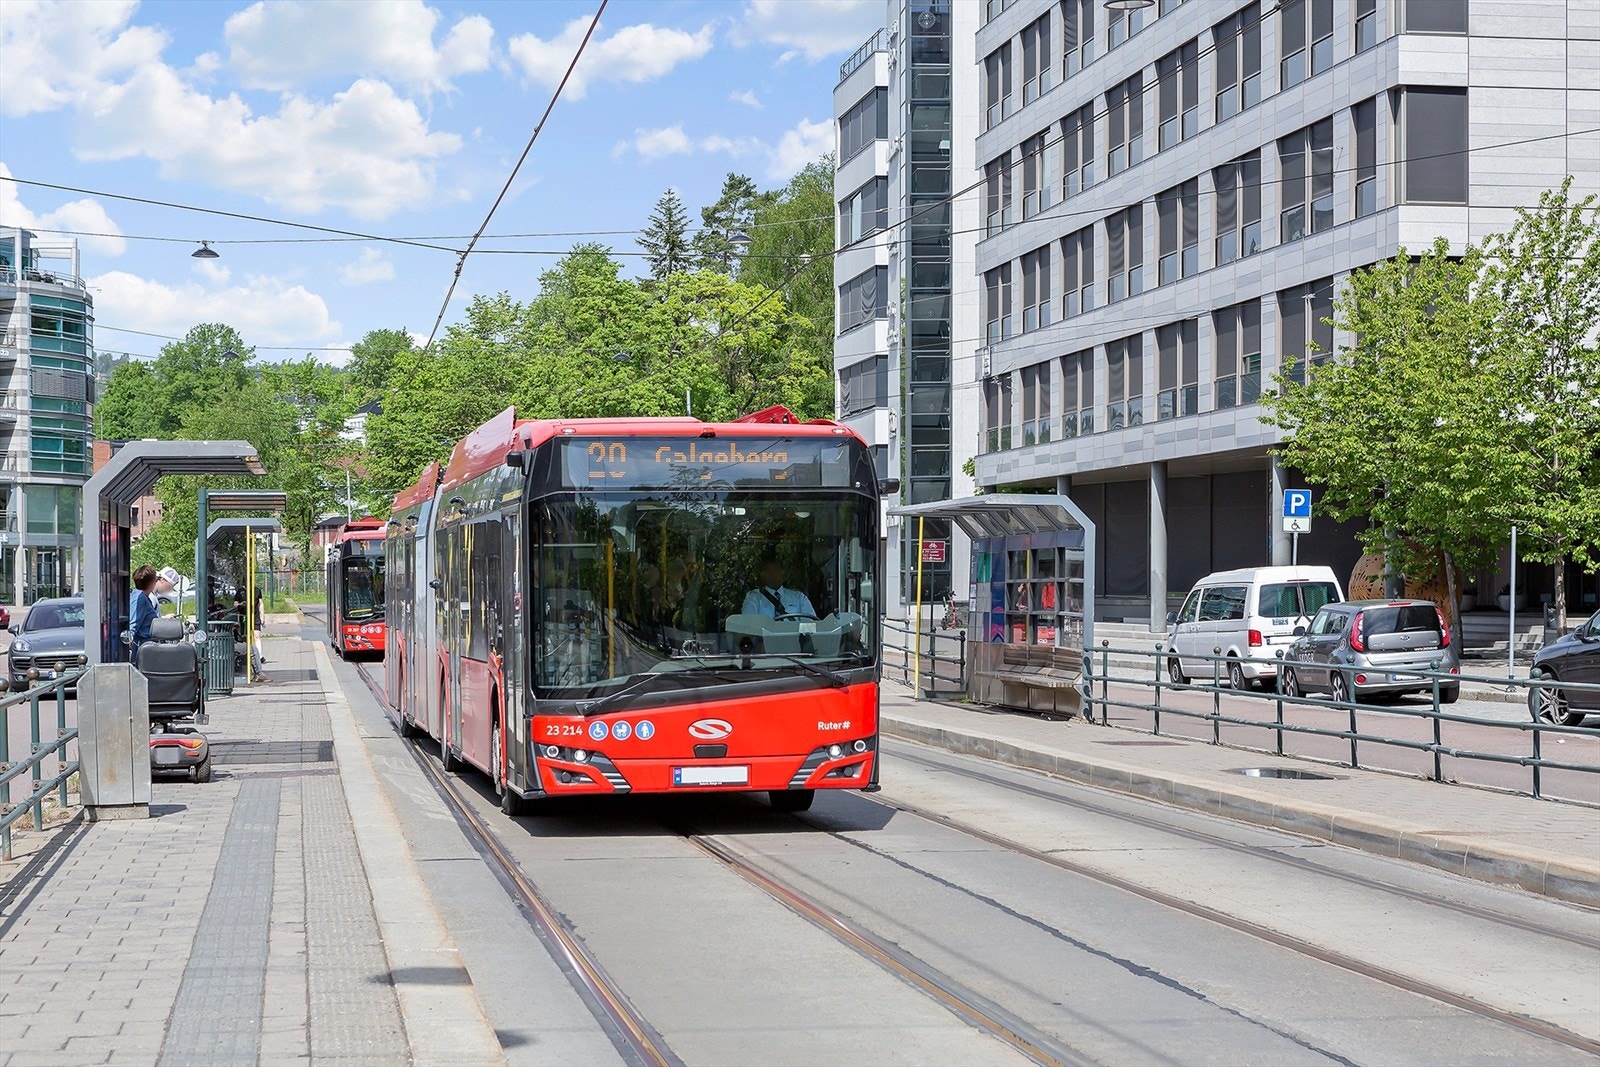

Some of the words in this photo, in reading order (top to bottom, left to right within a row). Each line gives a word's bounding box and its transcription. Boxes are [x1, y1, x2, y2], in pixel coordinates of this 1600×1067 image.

[588, 442, 626, 478] 20
[1291, 493, 1306, 515] P
[546, 724, 560, 736] 23
[562, 724, 584, 736] 214
[817, 720, 851, 731] Ruter#
